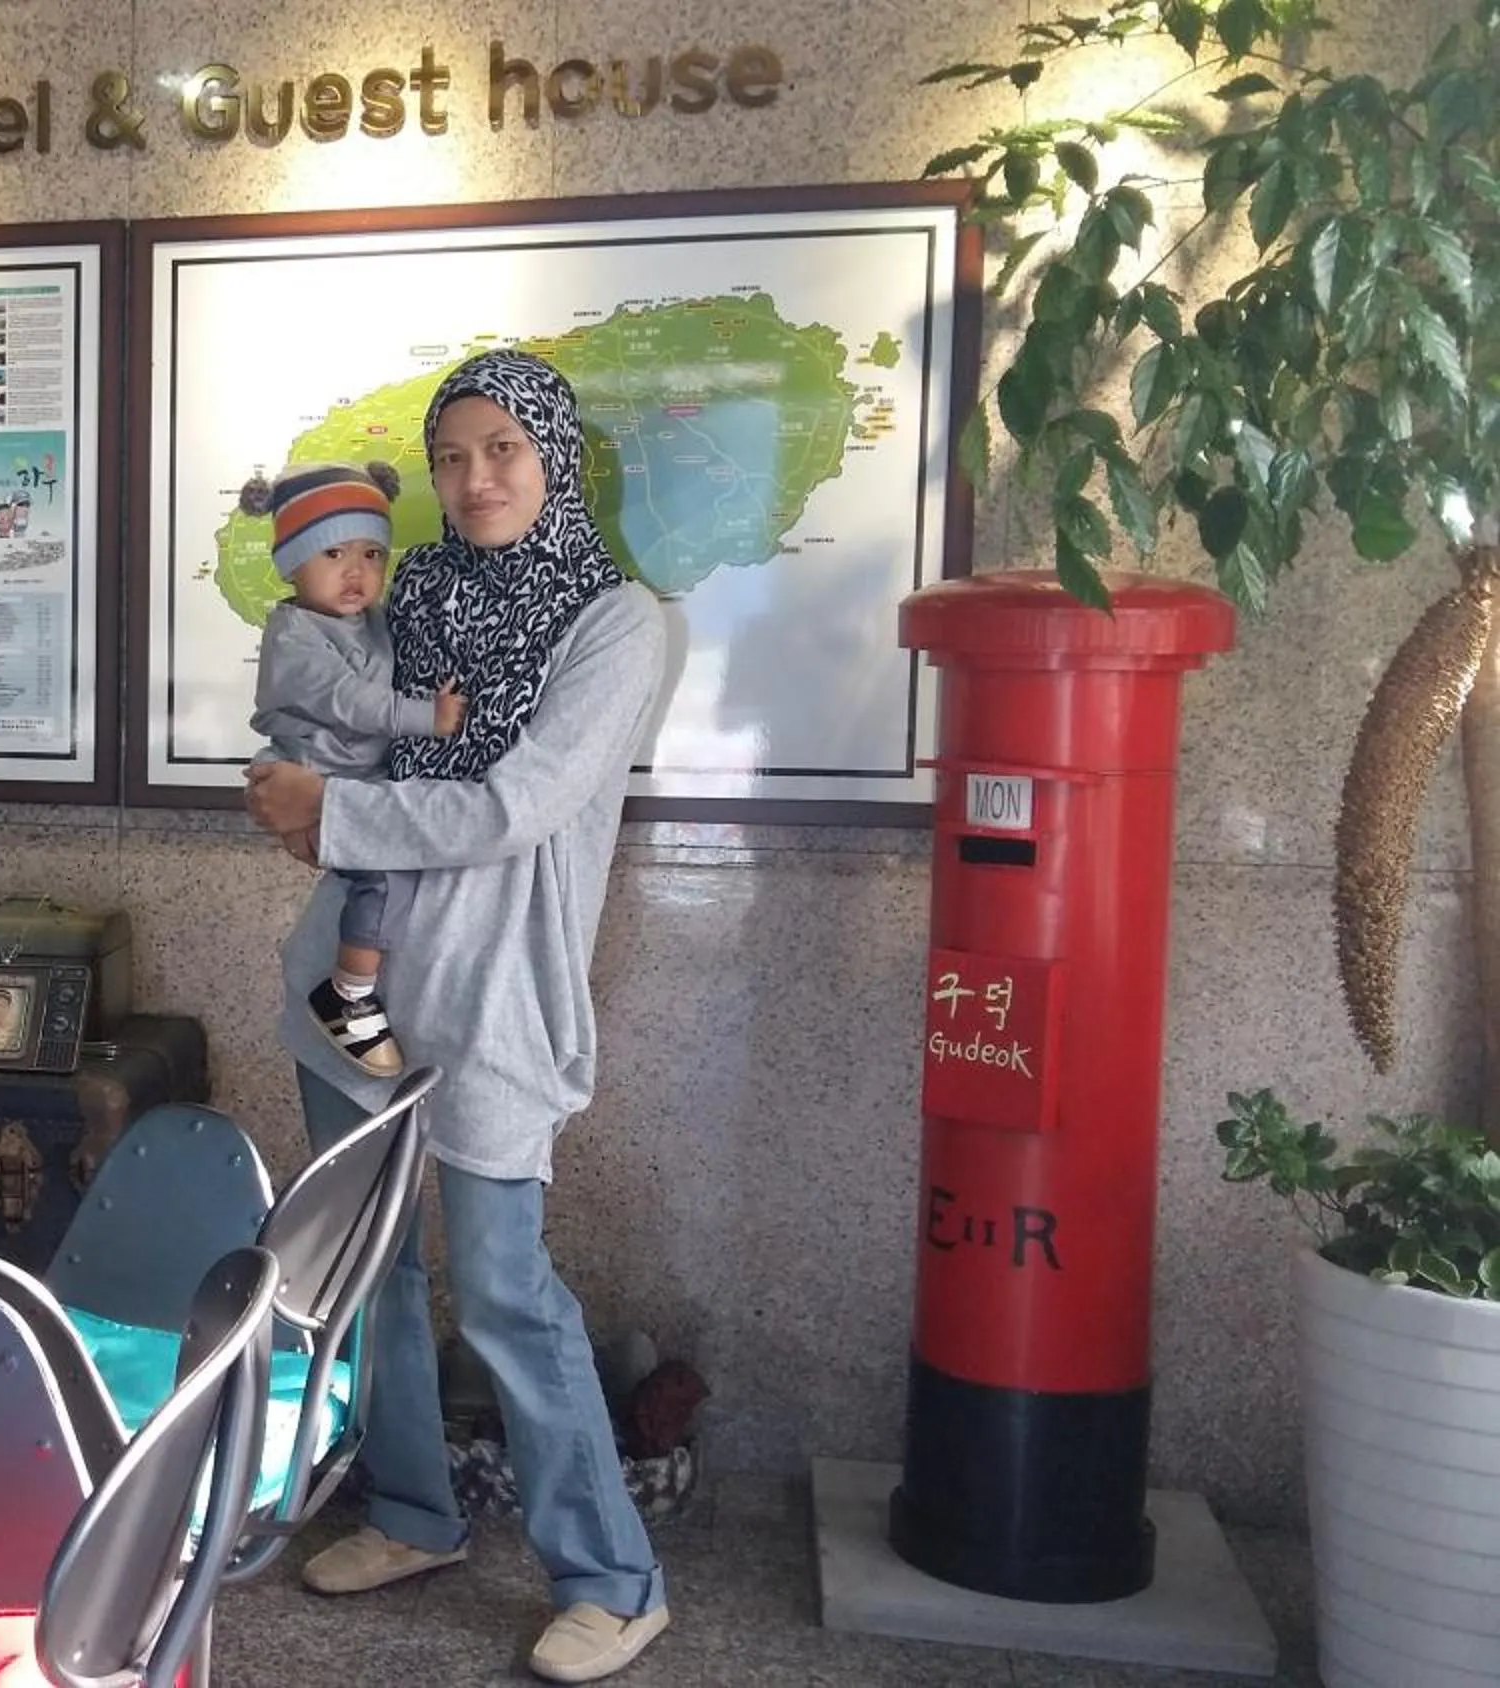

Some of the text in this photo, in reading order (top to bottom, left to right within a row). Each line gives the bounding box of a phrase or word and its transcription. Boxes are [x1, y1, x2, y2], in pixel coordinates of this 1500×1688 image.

[85, 70, 146, 150] &
[182, 45, 450, 146] Guest
[488, 39, 784, 131] house
[974, 781, 1022, 822] MON
